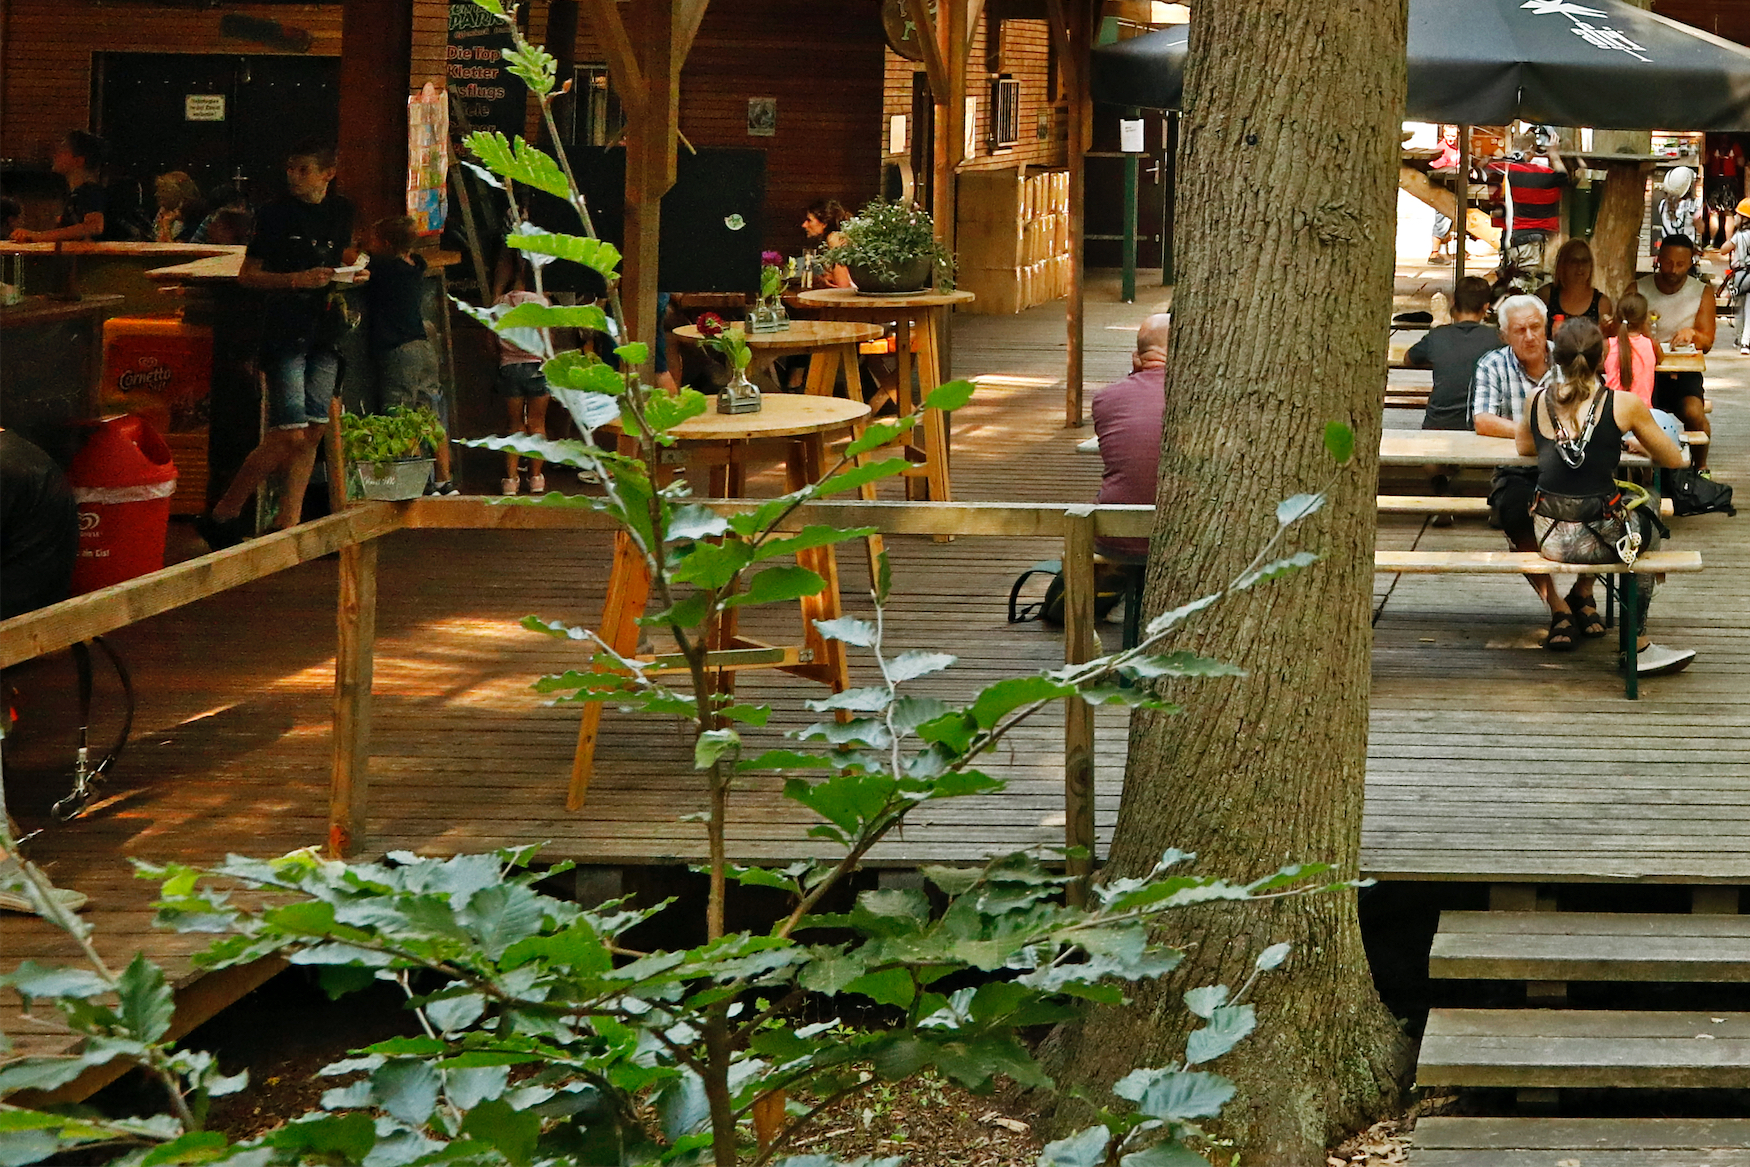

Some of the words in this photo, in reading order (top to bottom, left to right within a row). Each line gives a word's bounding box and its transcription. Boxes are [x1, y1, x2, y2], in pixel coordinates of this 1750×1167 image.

[446, 46, 472, 60] Die
[473, 46, 501, 63] Top
[446, 64, 500, 80] Kletter
[453, 84, 506, 101] sflugs
[119, 367, 171, 390] Cornetto
